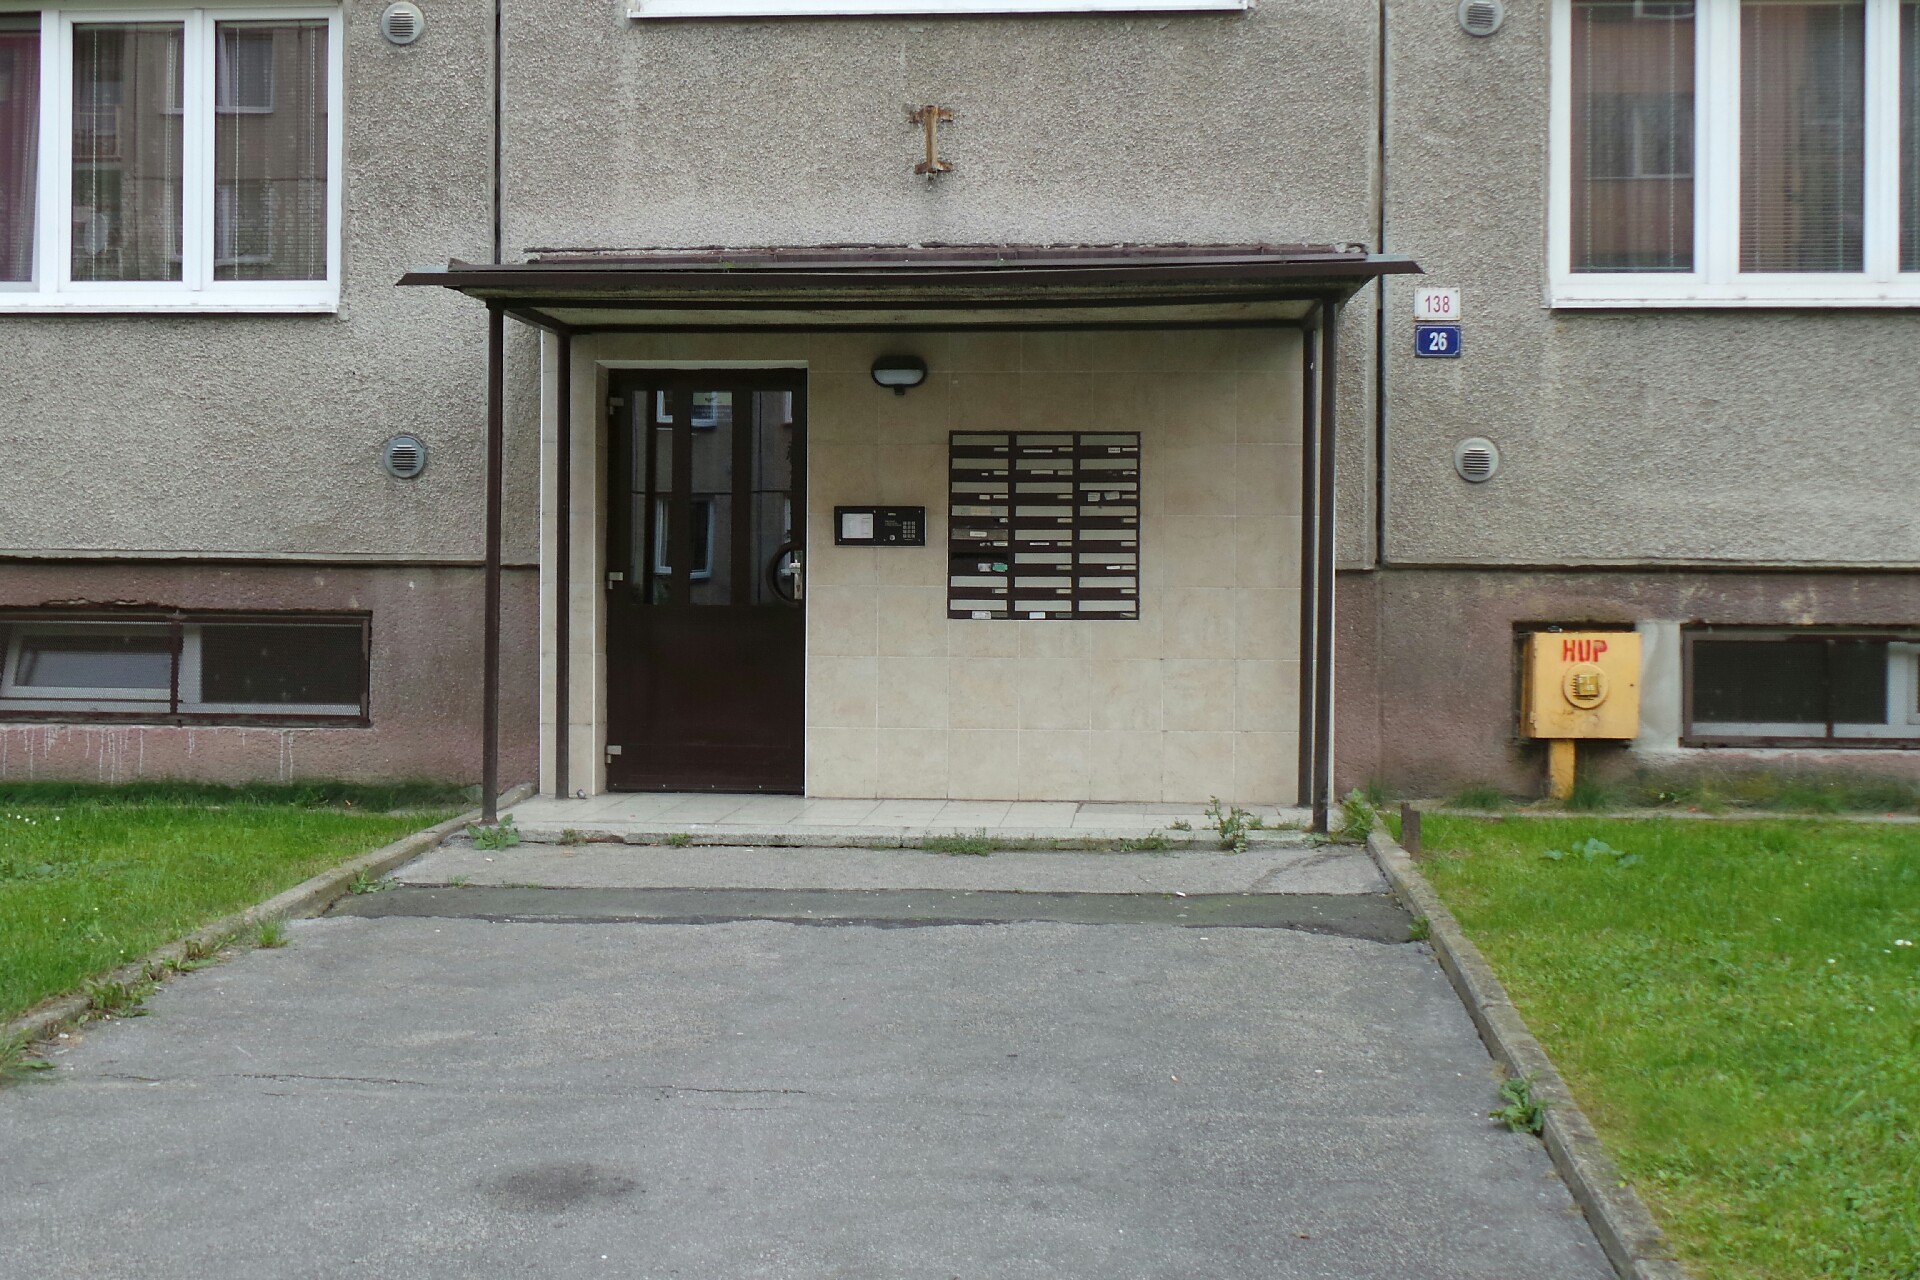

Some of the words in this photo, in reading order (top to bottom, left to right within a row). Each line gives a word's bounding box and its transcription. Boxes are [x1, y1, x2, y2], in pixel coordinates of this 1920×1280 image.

[1425, 295, 1450, 313] 138
[1429, 332, 1448, 351] 26
[1562, 639, 1608, 662] HUP
